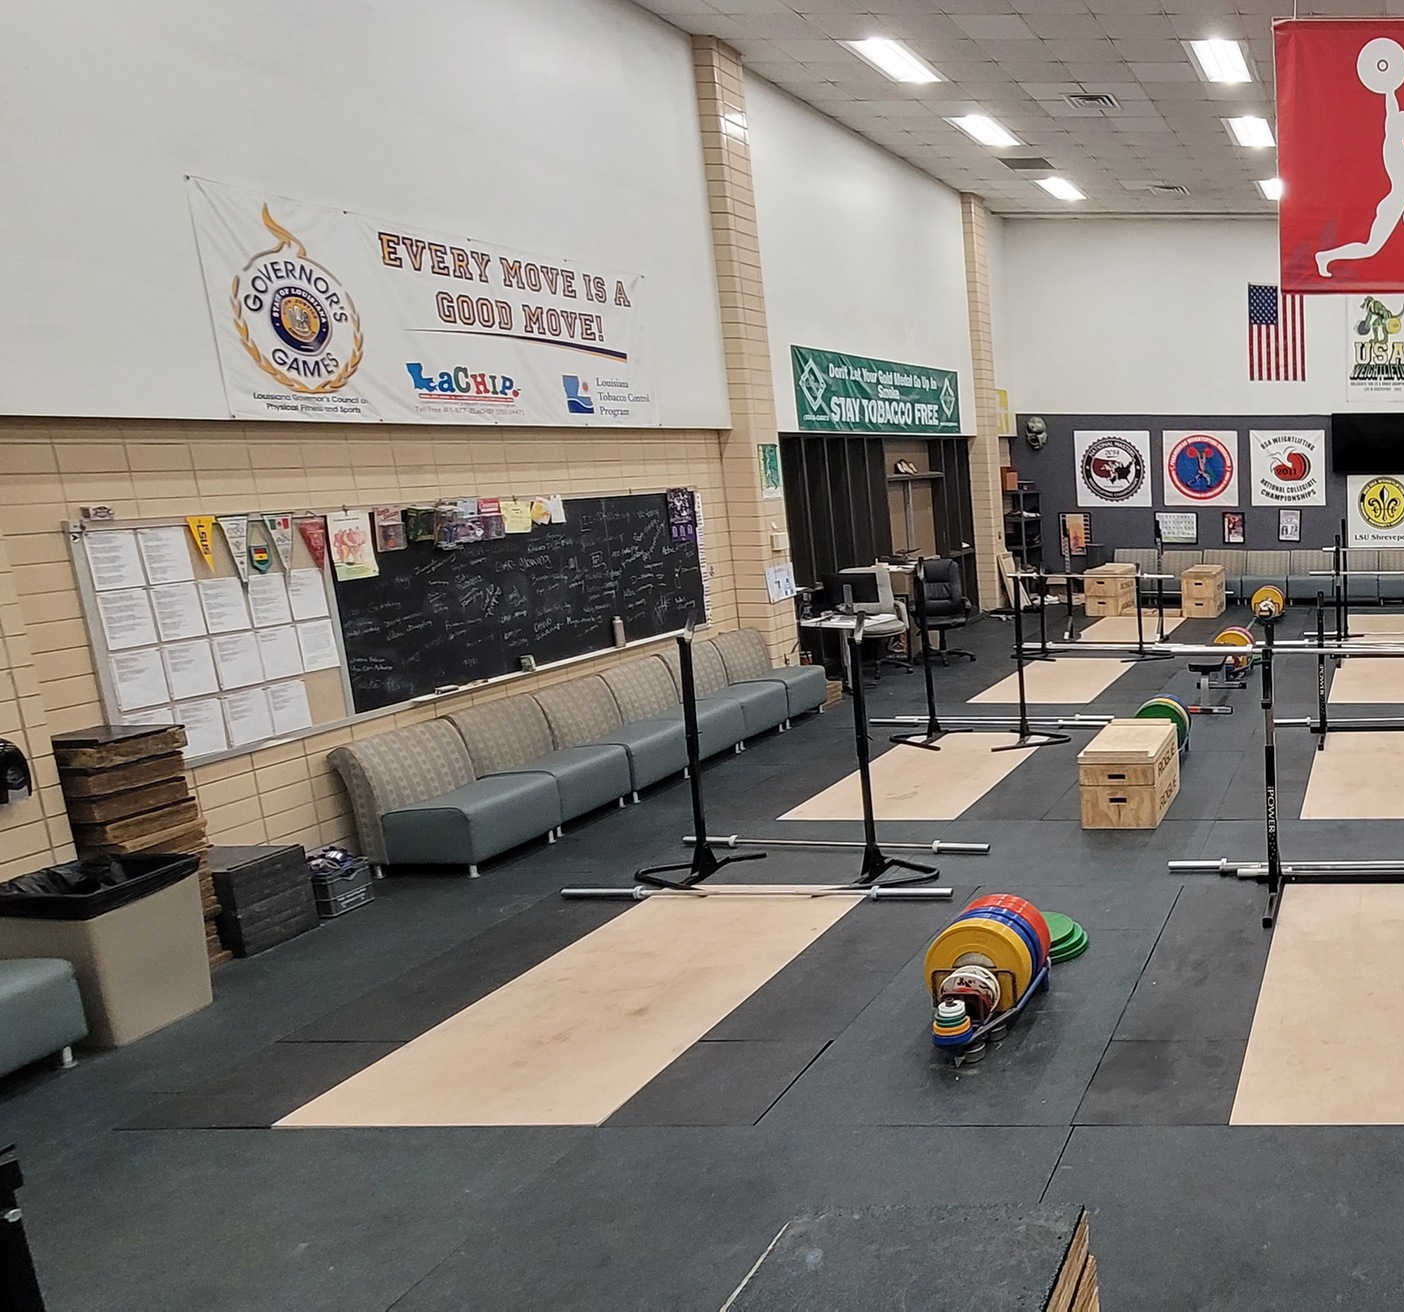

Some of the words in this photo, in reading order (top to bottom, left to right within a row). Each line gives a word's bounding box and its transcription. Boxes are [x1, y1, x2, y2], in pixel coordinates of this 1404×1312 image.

[378, 231, 491, 283] EVERY
[499, 256, 577, 299] MOVE
[583, 274, 607, 303] IS
[614, 280, 631, 307] A
[243, 260, 349, 325] GOVERNOR'S
[291, 288, 327, 324] LOUISIANA
[435, 291, 513, 331] GOOD
[522, 304, 604, 342] MOVE!
[271, 348, 339, 378] GAMES
[596, 377, 629, 389] Louisiana
[828, 363, 849, 380] Don't
[850, 367, 862, 380] Let
[862, 368, 878, 383] Your
[878, 370, 893, 385] Gold
[894, 372, 913, 388] Medal
[913, 375, 921, 388] Go
[921, 377, 930, 391] Up
[930, 377, 937, 390] In
[253, 392, 291, 401] Louisiana
[332, 396, 359, 404] Council
[597, 391, 626, 402] Tobacco
[628, 393, 651, 403] Control
[877, 386, 900, 400] Smoke
[266, 403, 299, 413] Physical
[340, 406, 361, 415] Sports
[599, 407, 630, 418] Program
[830, 396, 861, 423] STAY
[862, 399, 913, 425] TOBACCO
[914, 403, 939, 426] FREE
[1089, 441, 1113, 458] NATIONAL
[1260, 440, 1272, 450] USA
[1272, 436, 1316, 451] WEIGHTLIFTING
[1260, 478, 1285, 493] NATIONAL
[1286, 478, 1317, 493] COLLEGIATE
[1260, 489, 1317, 502] CHAMPIONSHIPS
[196, 524, 212, 556] LSUS
[1157, 741, 1176, 778] ROGUE
[1158, 775, 1178, 811] ROGUE
